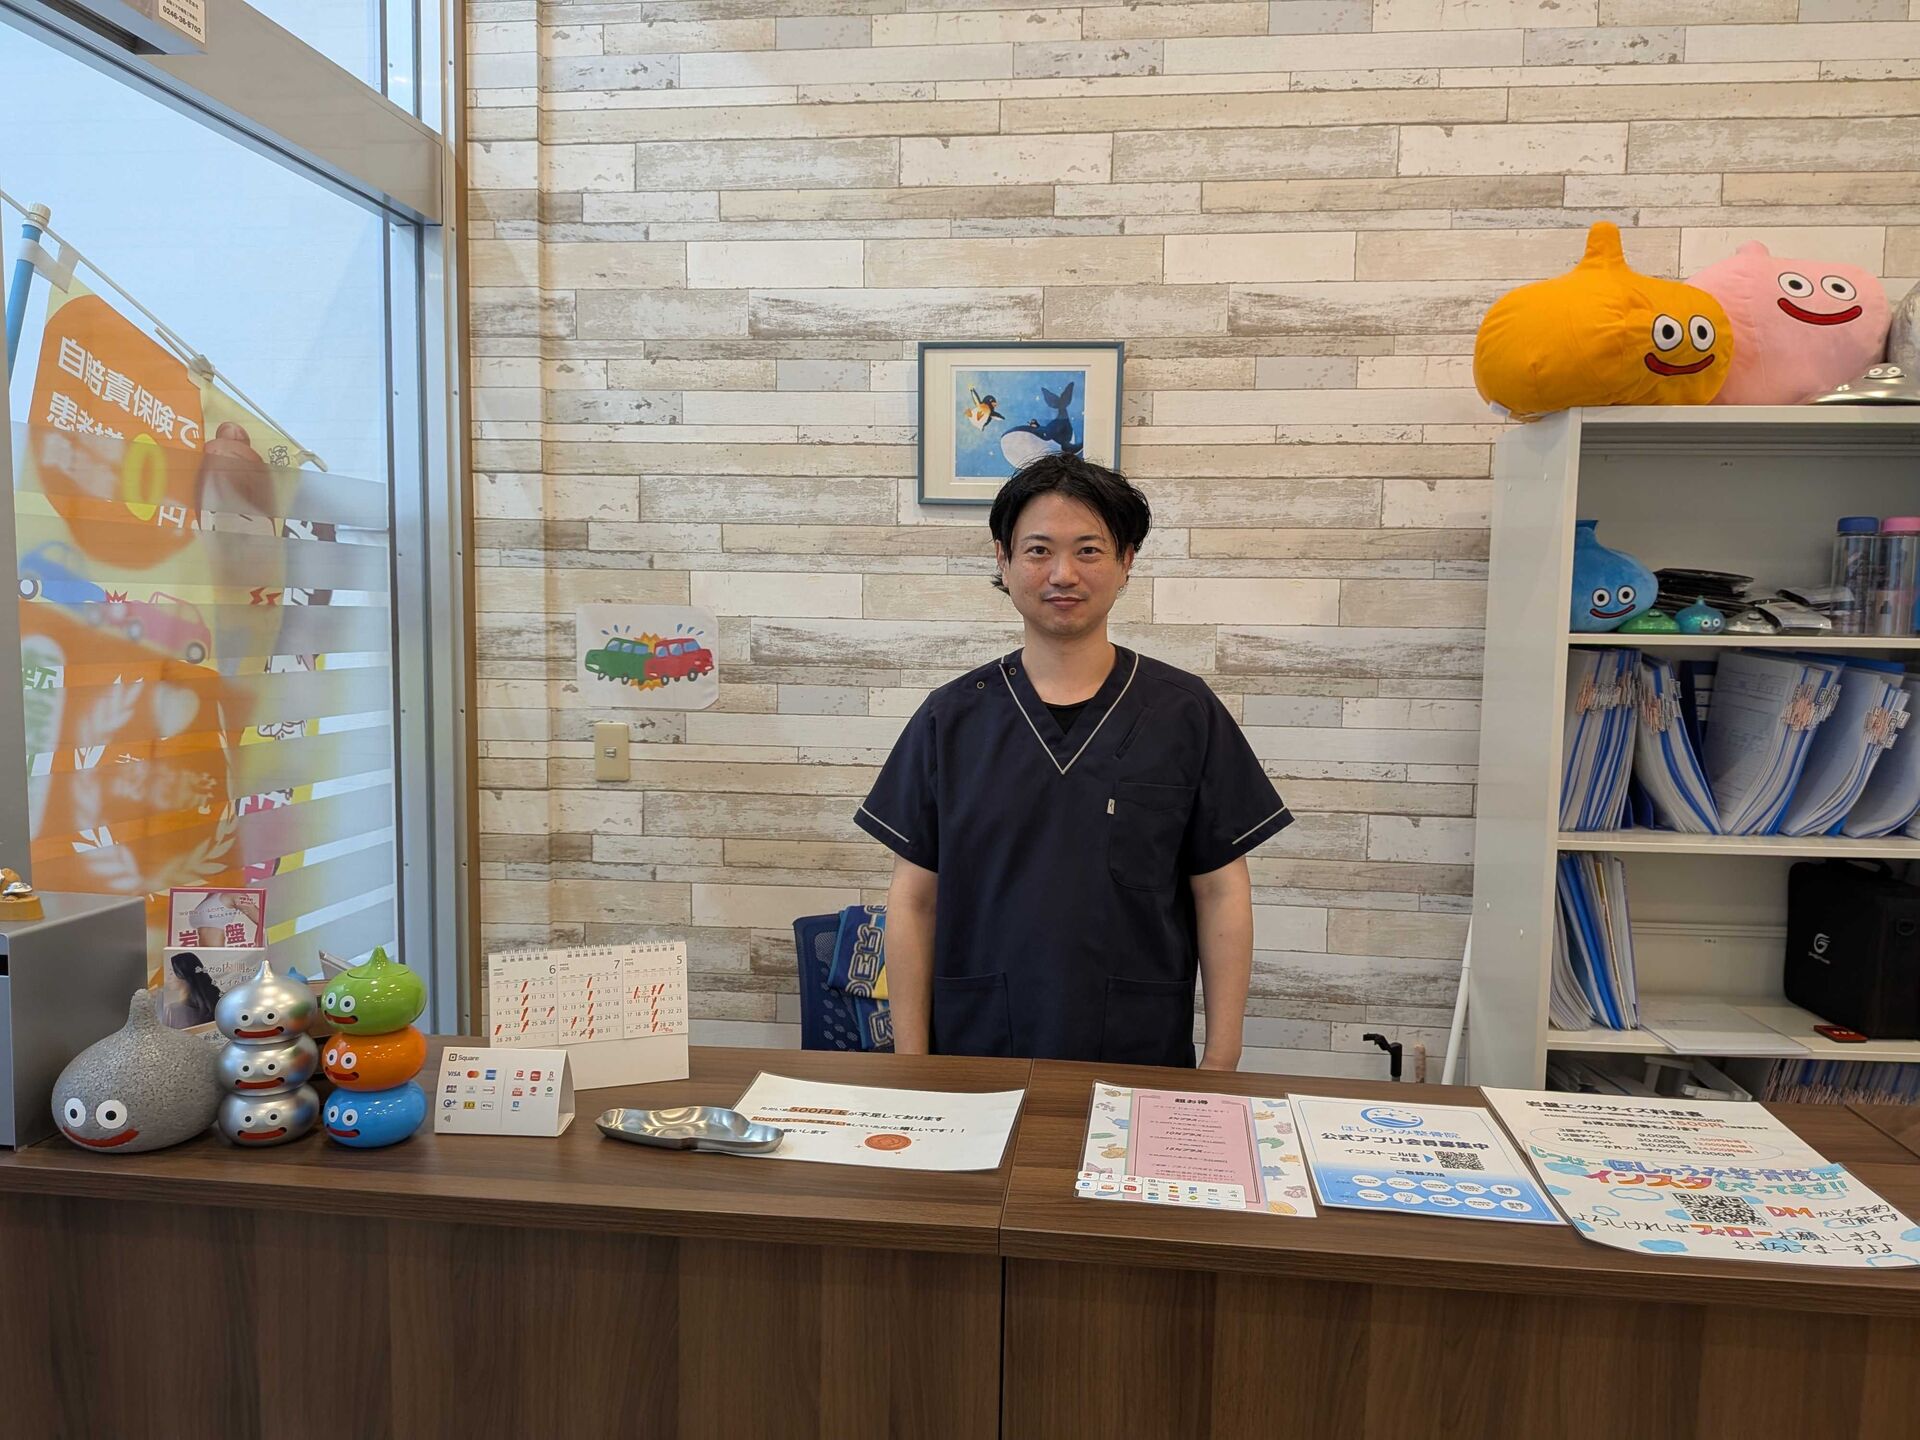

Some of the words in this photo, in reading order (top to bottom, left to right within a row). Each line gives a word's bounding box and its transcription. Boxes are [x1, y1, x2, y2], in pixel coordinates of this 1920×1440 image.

[57, 335, 200, 449] 自賠責保険で
[614, 960, 620, 969] 7
[676, 955, 683, 964] 5
[549, 964, 556, 974] 6
[1526, 1100, 1704, 1118] 岩盤エクササイズ料金表
[1321, 1132, 1489, 1150] 公式アプリ会員募集中
[1344, 1148, 1419, 1158] インストールは
